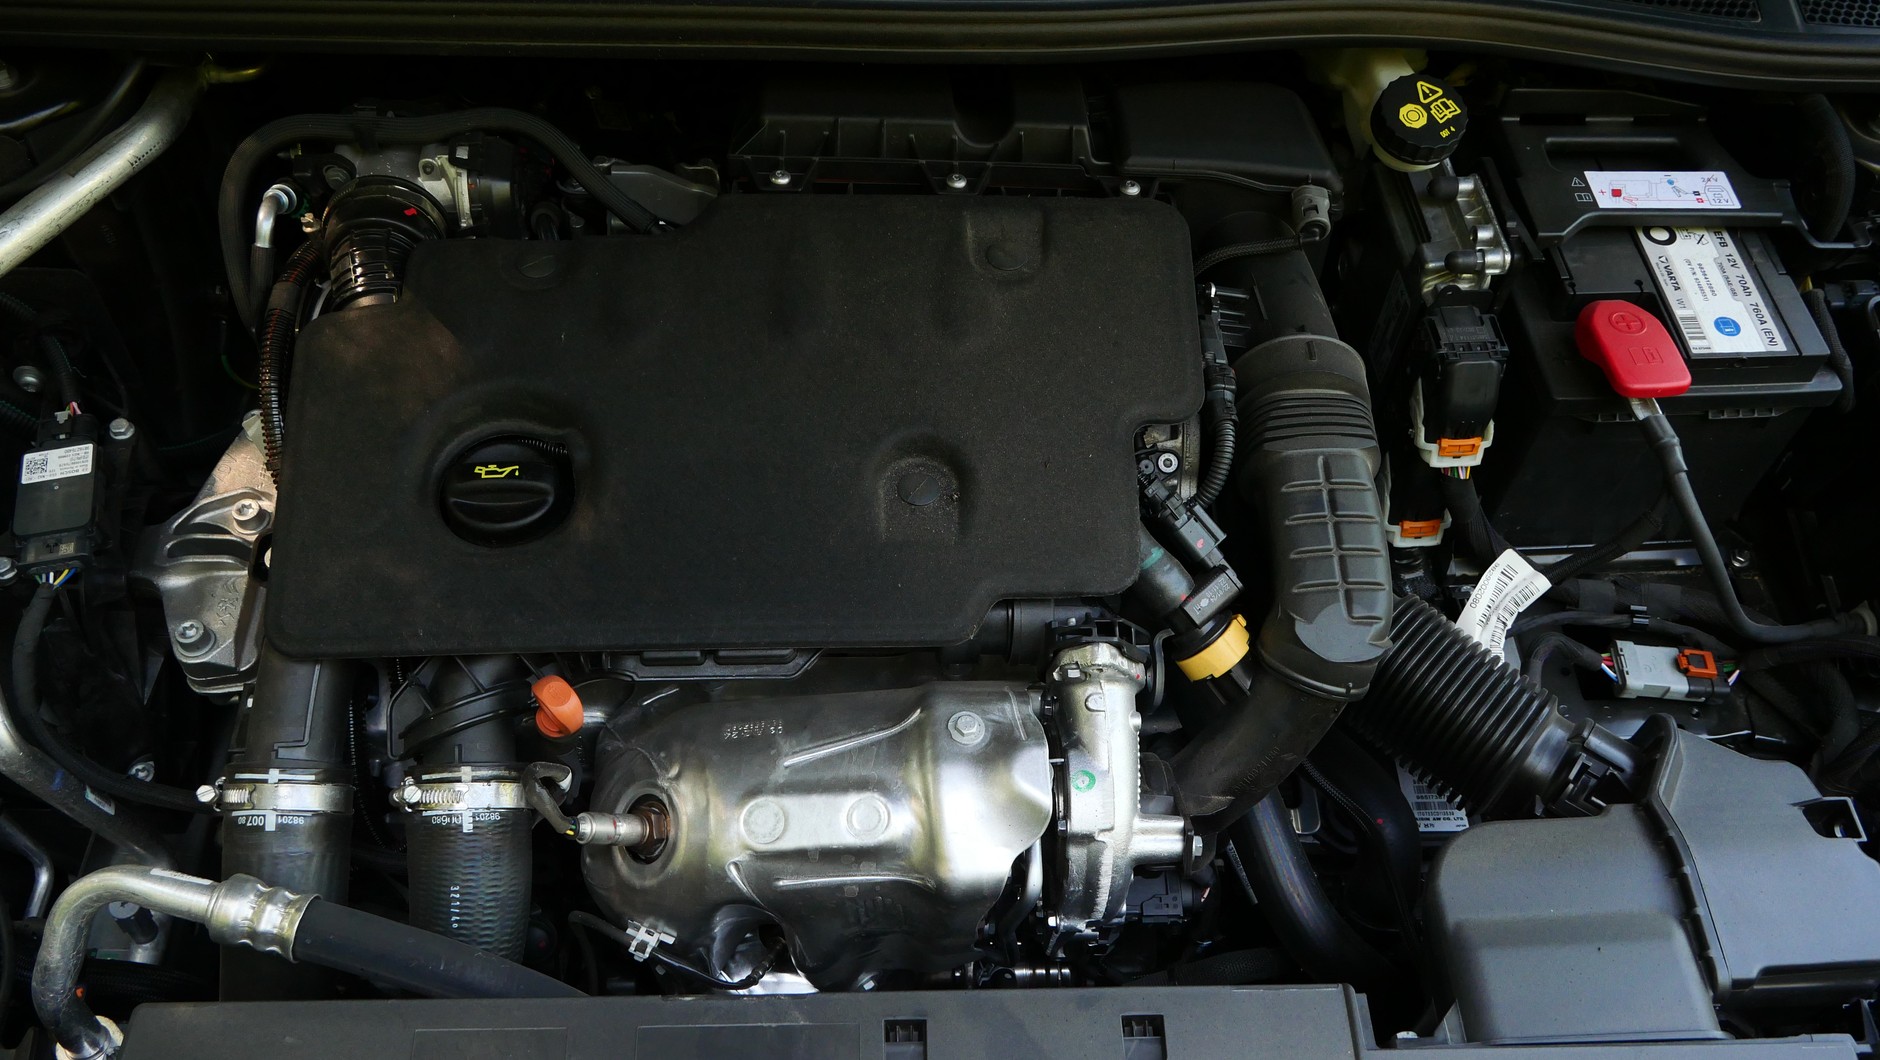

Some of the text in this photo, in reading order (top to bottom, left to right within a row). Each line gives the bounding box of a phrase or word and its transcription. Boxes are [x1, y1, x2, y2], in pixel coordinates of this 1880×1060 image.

[1439, 128, 1451, 138] DOT
[1663, 264, 1687, 309] VARTA W1
[1714, 231, 1778, 347] EFB 12V 70Ah 760A (EN)
[278, 815, 304, 825] 98201
[475, 811, 501, 822] 98201
